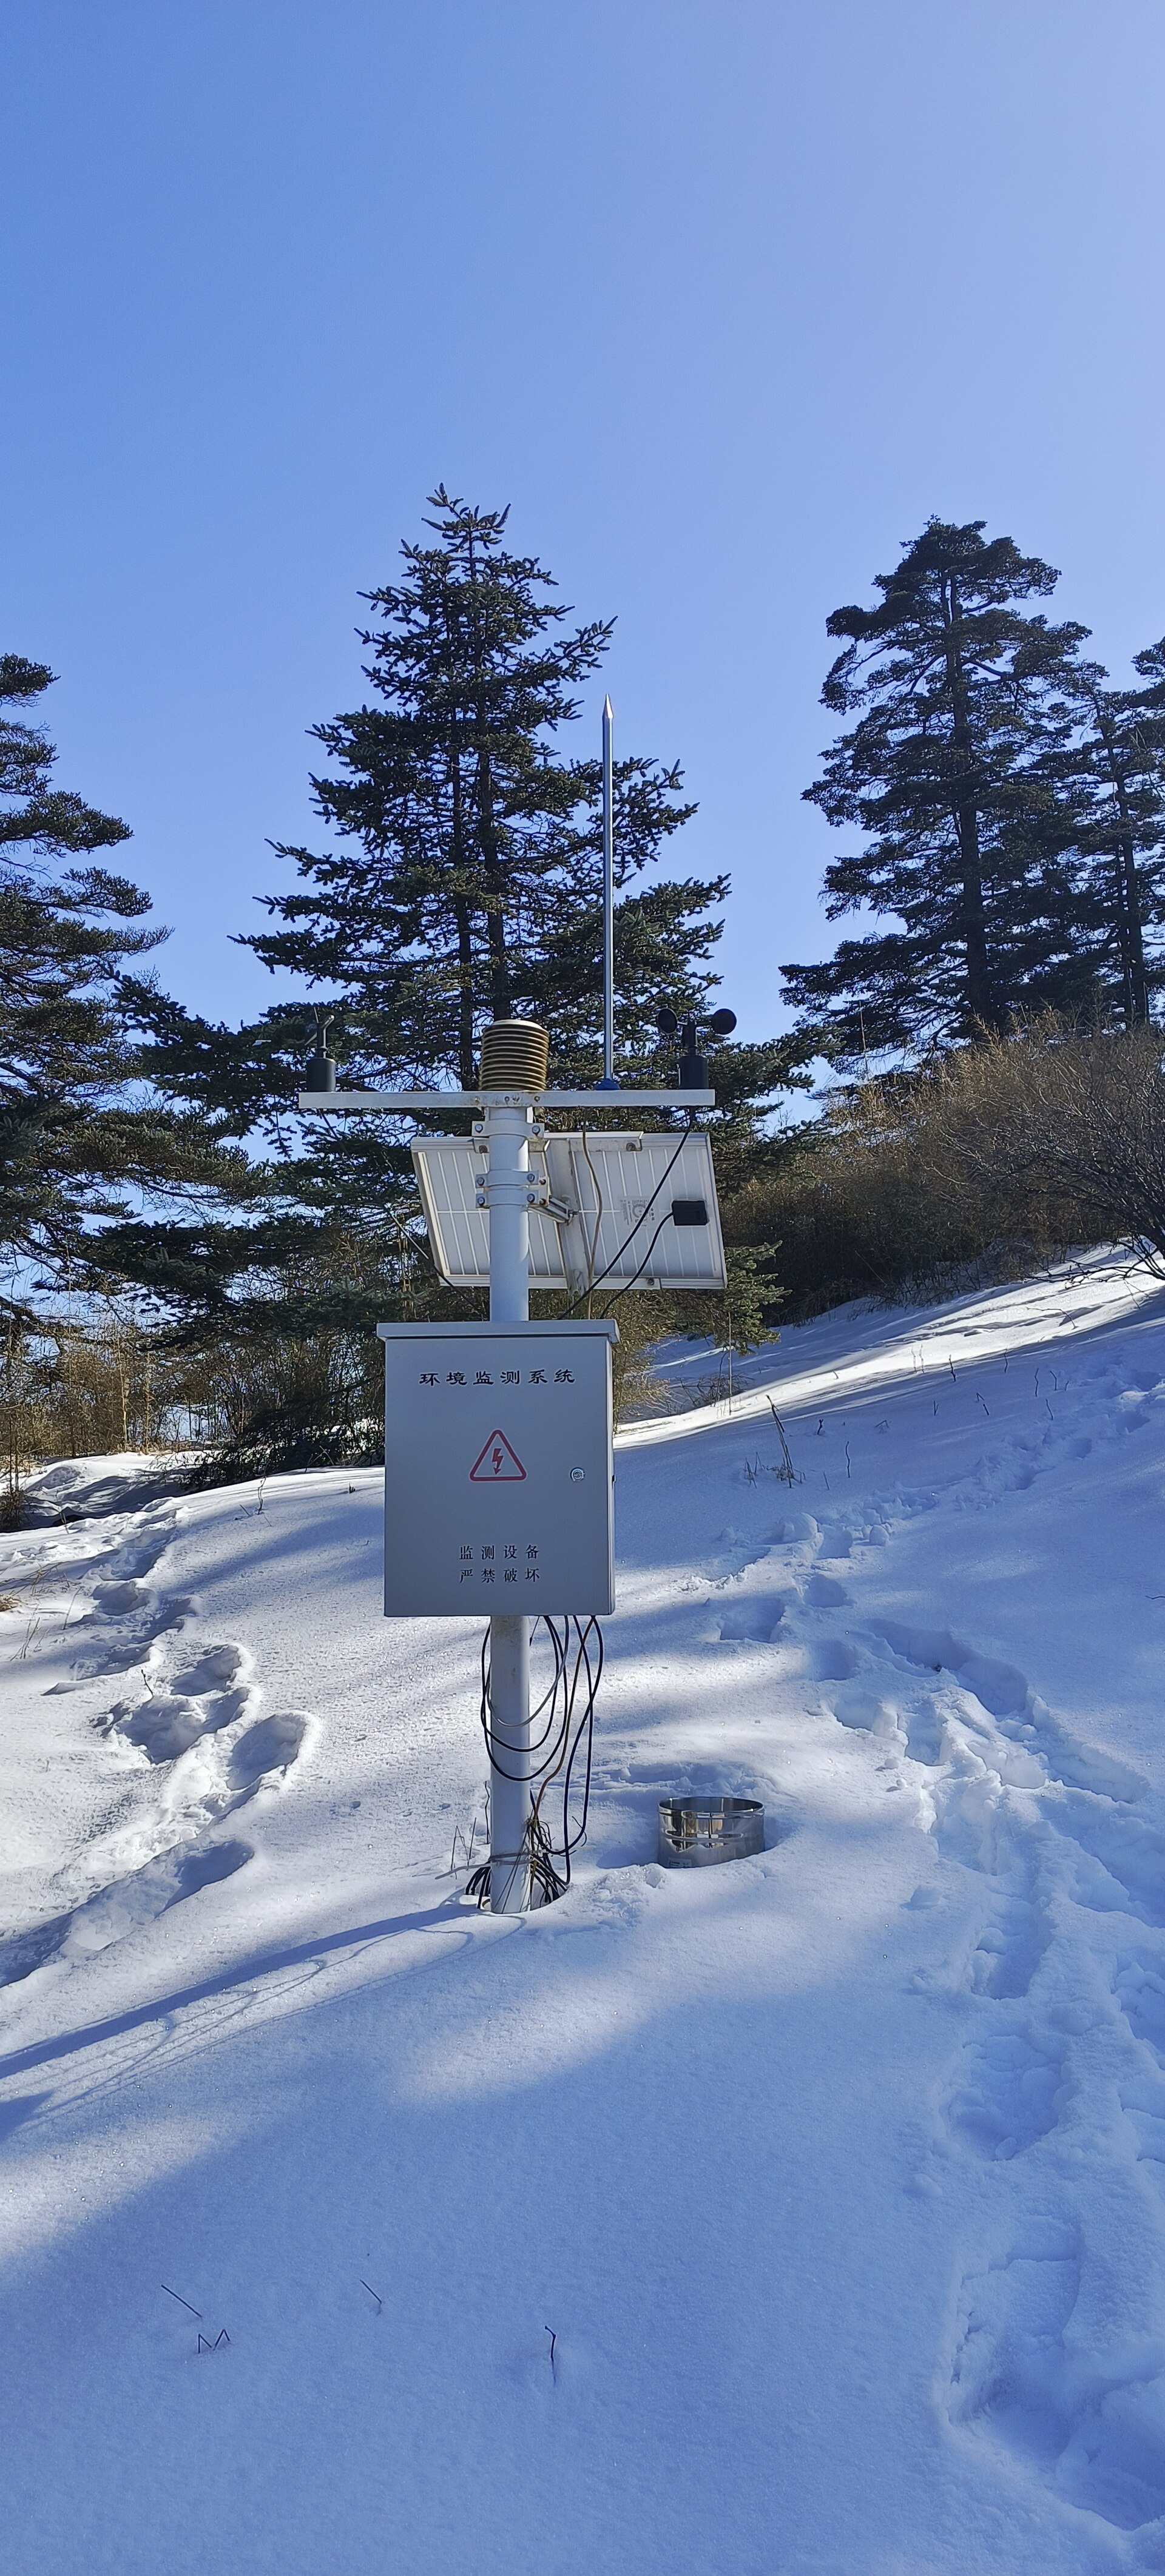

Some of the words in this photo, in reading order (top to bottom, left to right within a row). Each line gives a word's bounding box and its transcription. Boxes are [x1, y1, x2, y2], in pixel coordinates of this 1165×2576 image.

[419, 1369, 575, 1387] 环境监测系统
[459, 1544, 539, 1560] 监测设备
[459, 1568, 540, 1584] 严禁破坏
